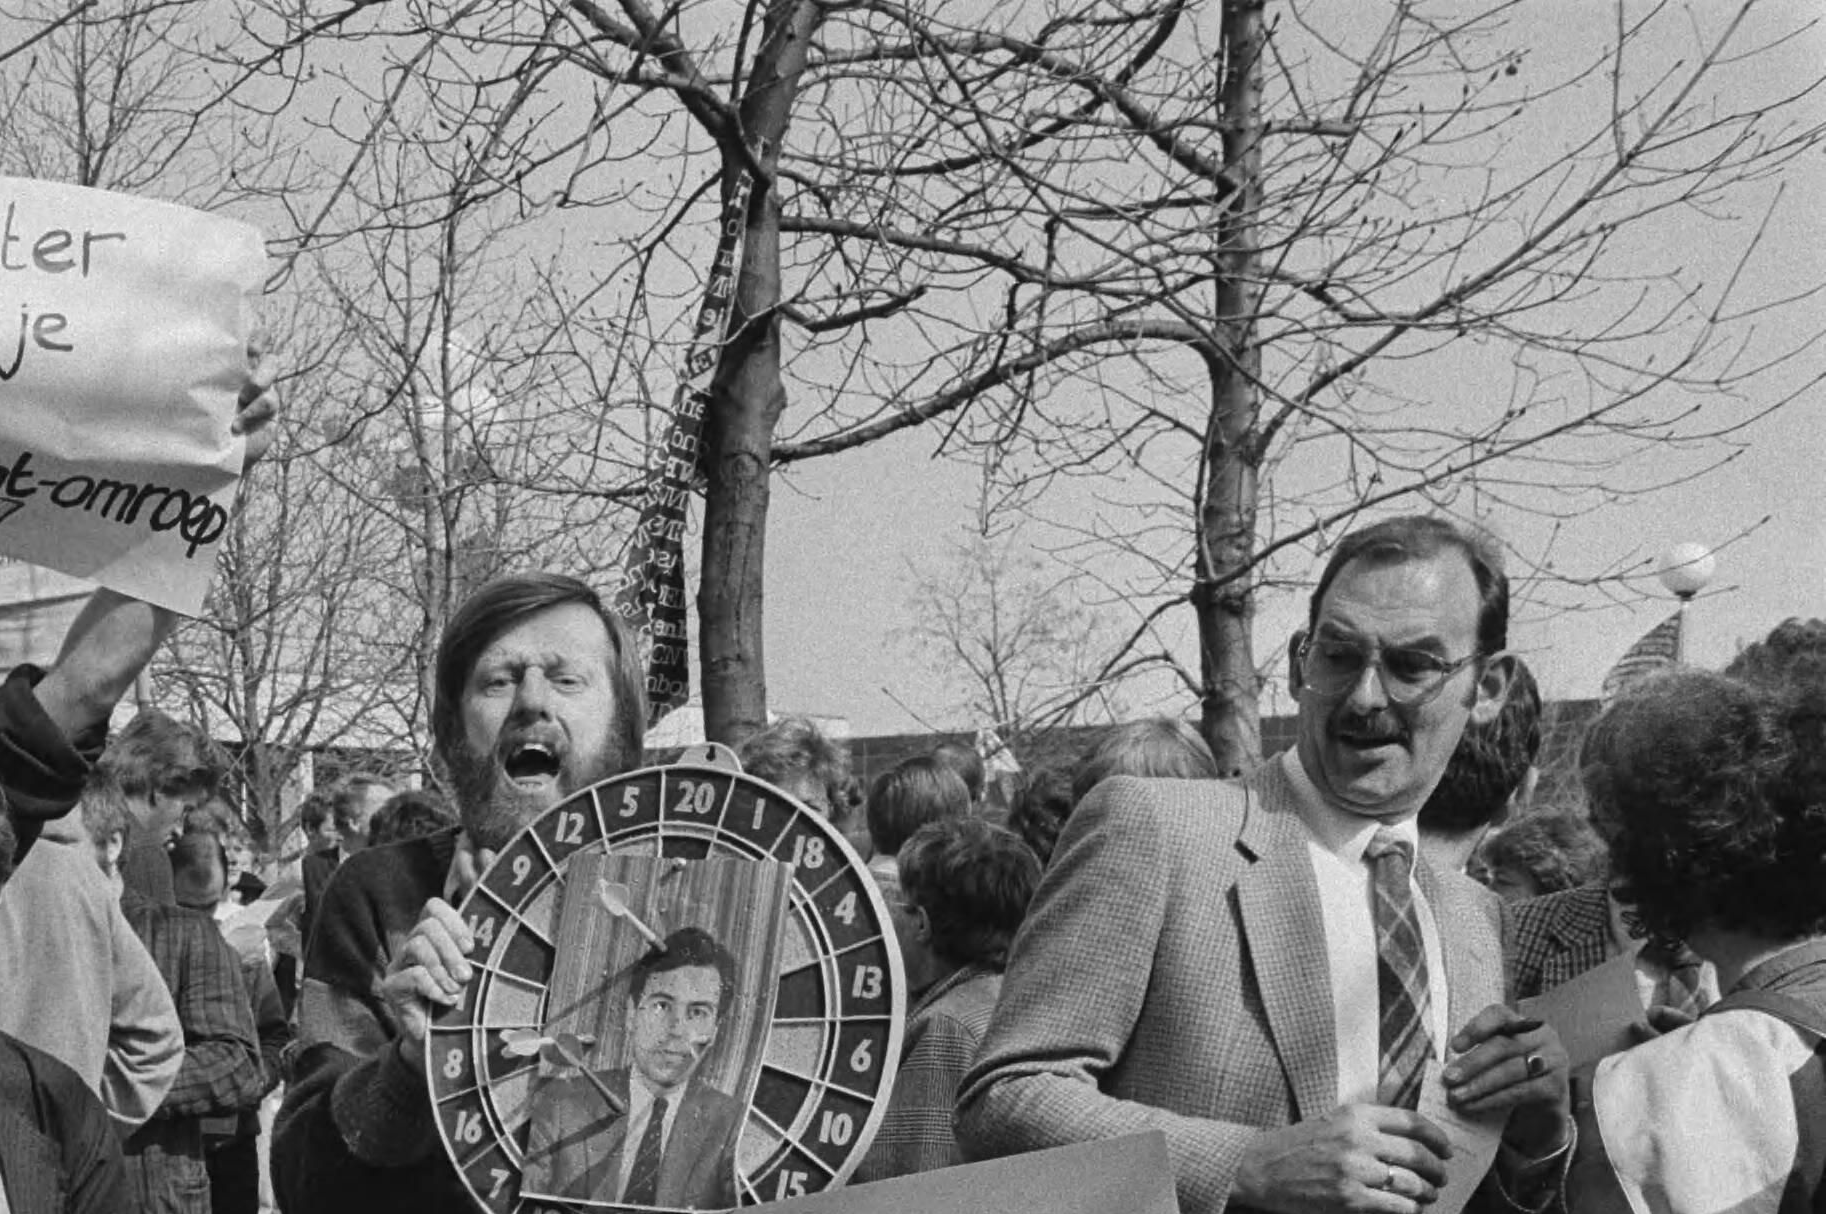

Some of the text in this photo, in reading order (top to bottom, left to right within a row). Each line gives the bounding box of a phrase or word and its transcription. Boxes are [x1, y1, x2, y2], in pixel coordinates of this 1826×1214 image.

[621, 787, 640, 817] 5
[674, 782, 715, 814] 20
[555, 812, 584, 844] 12
[753, 799, 765, 829] 1
[792, 835, 825, 868] 18
[511, 855, 531, 885] 9
[834, 892, 856, 923] 4
[852, 965, 883, 998] 13
[443, 1049, 463, 1078] 8
[851, 1039, 872, 1071] 6
[455, 1112, 482, 1143] 16
[819, 1112, 852, 1145] 10
[490, 1169, 510, 1198] 7
[777, 1169, 807, 1198] 15
